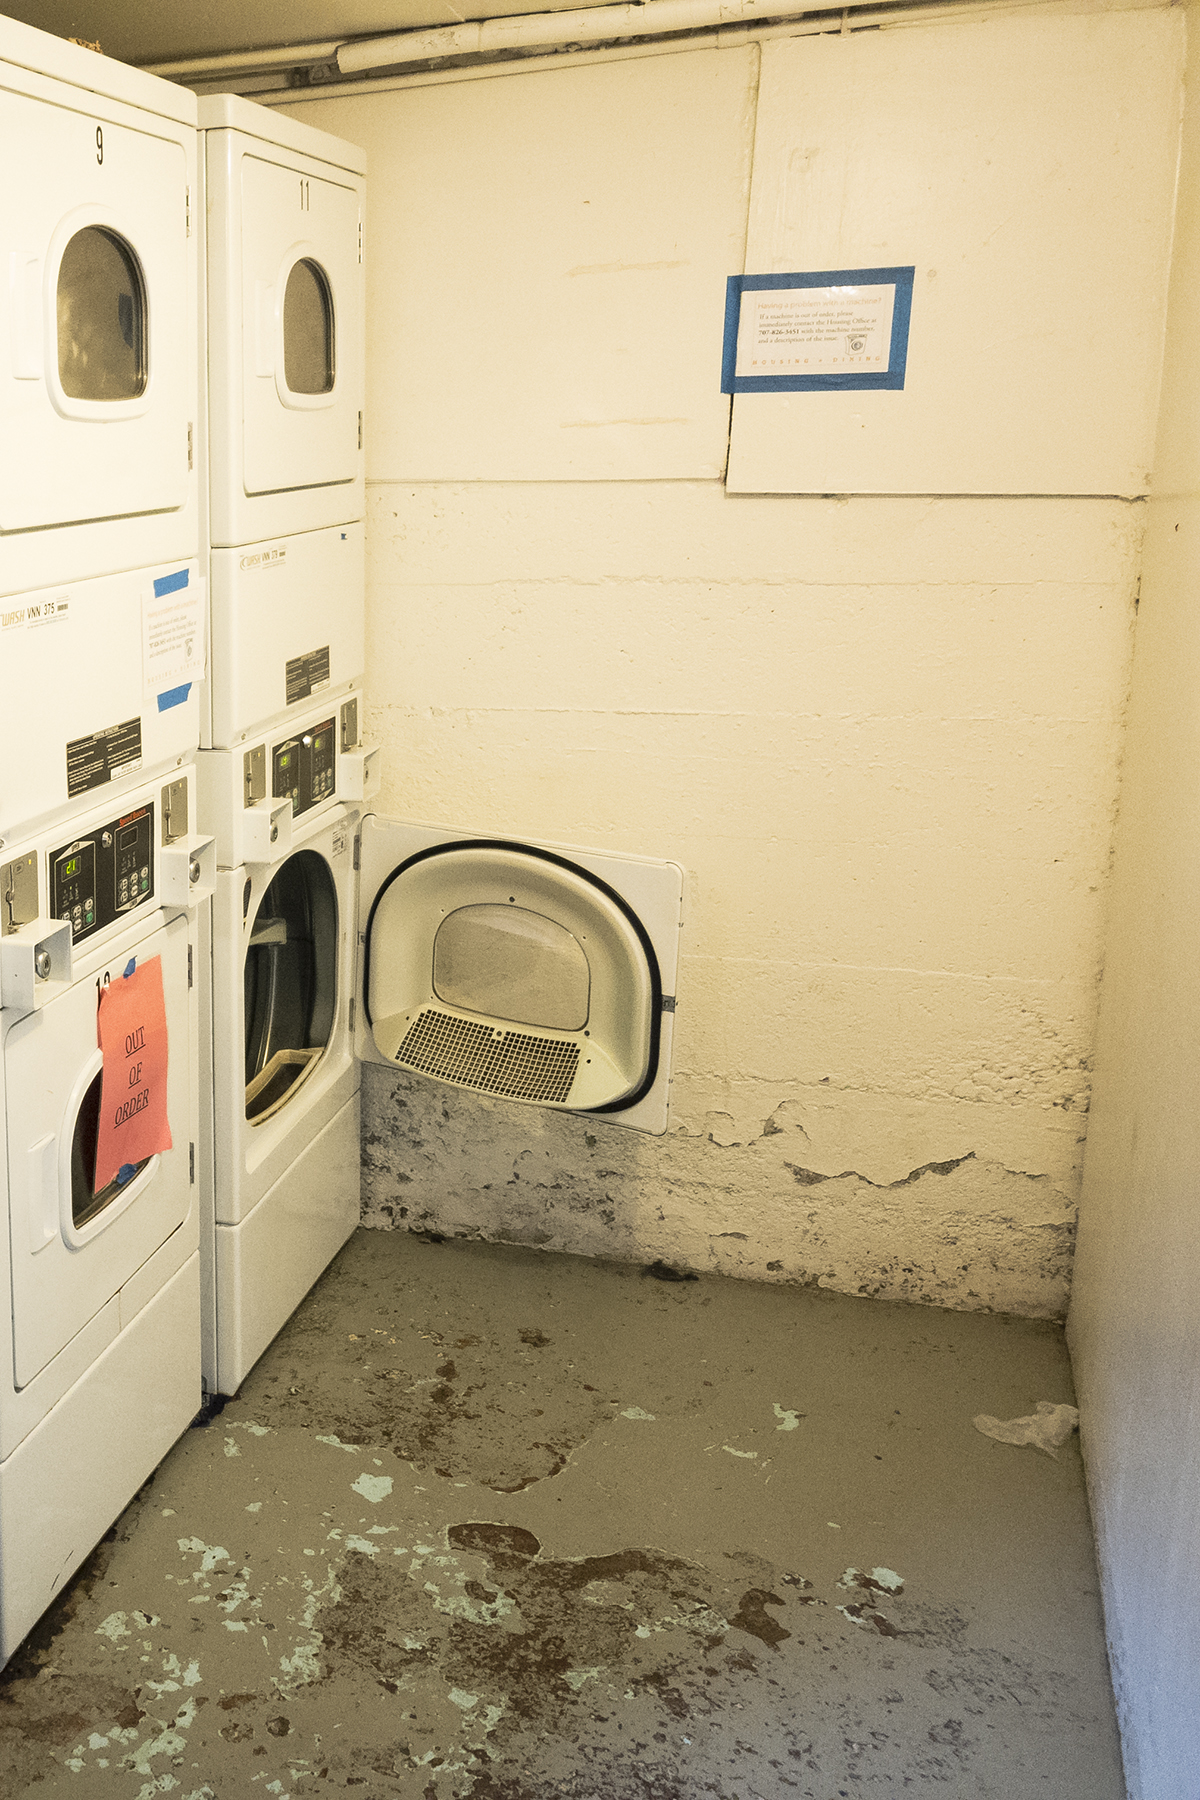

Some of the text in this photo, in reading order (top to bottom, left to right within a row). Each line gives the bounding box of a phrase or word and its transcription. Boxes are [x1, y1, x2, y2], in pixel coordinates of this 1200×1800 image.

[96, 125, 103, 165] 9
[300, 179, 309, 211] 11
[2, 609, 26, 627] WASH
[27, 605, 41, 619] VNN
[43, 602, 55, 615] 375
[125, 1026, 145, 1054] OUT
[129, 1062, 143, 1085] OF
[114, 1088, 150, 1125] ORDER
